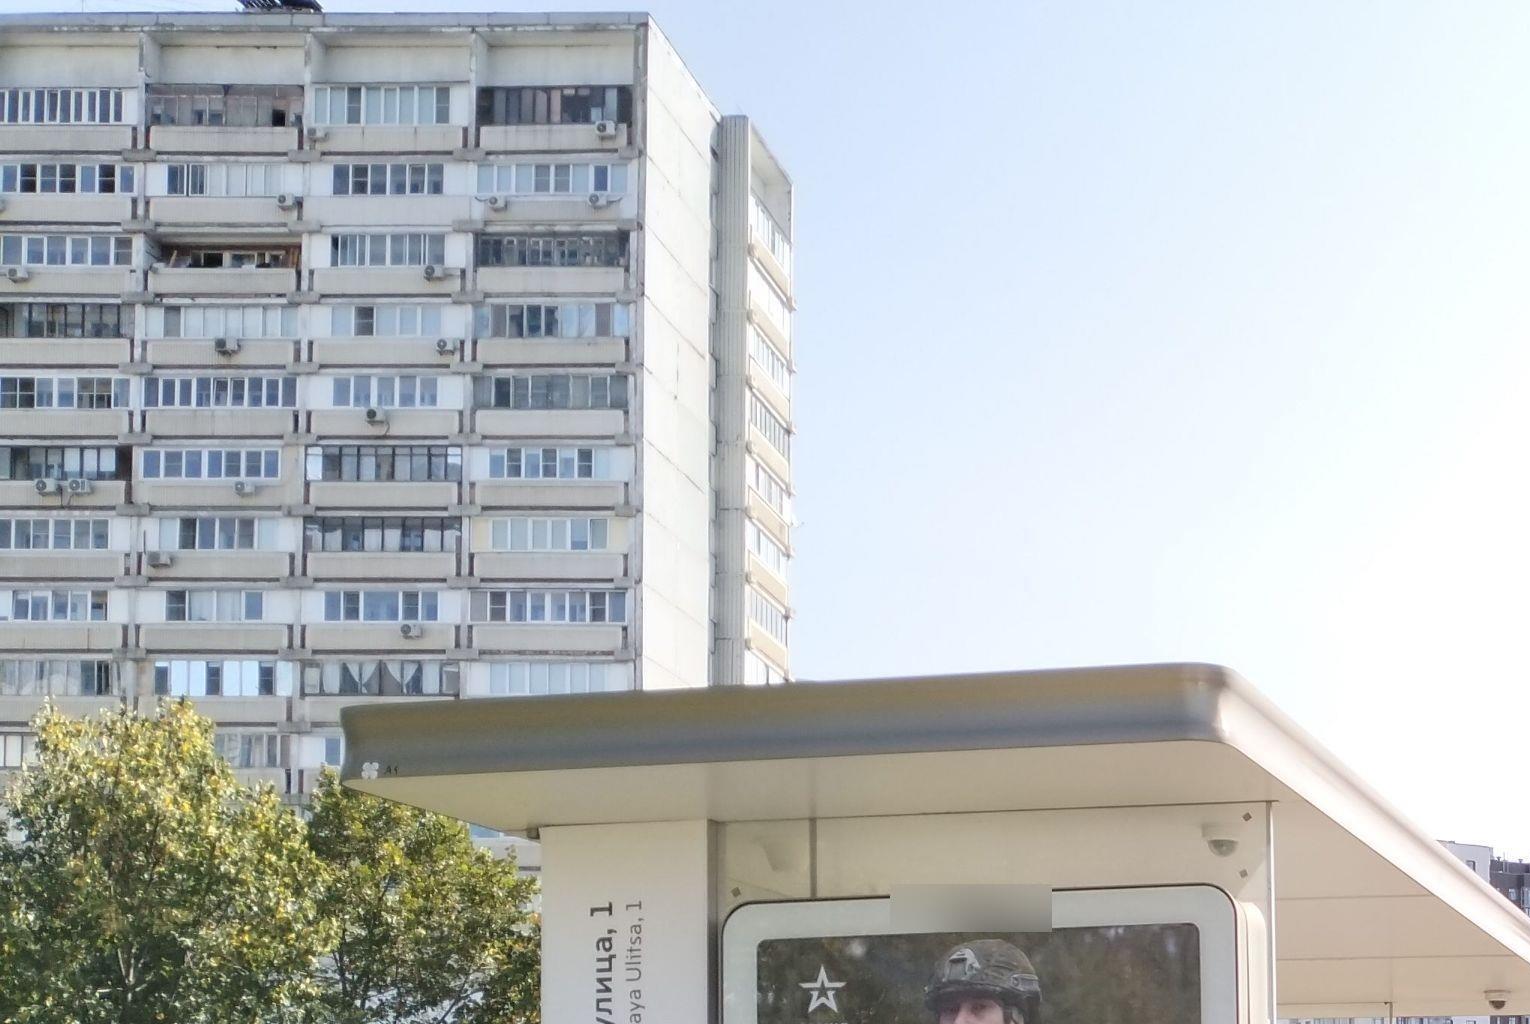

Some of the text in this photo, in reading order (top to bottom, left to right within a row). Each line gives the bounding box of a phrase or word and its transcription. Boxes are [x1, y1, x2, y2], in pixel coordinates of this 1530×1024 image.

[590, 901, 613, 917] 1
[625, 900, 642, 910] 1
[625, 917, 645, 981] Ulitsa,
